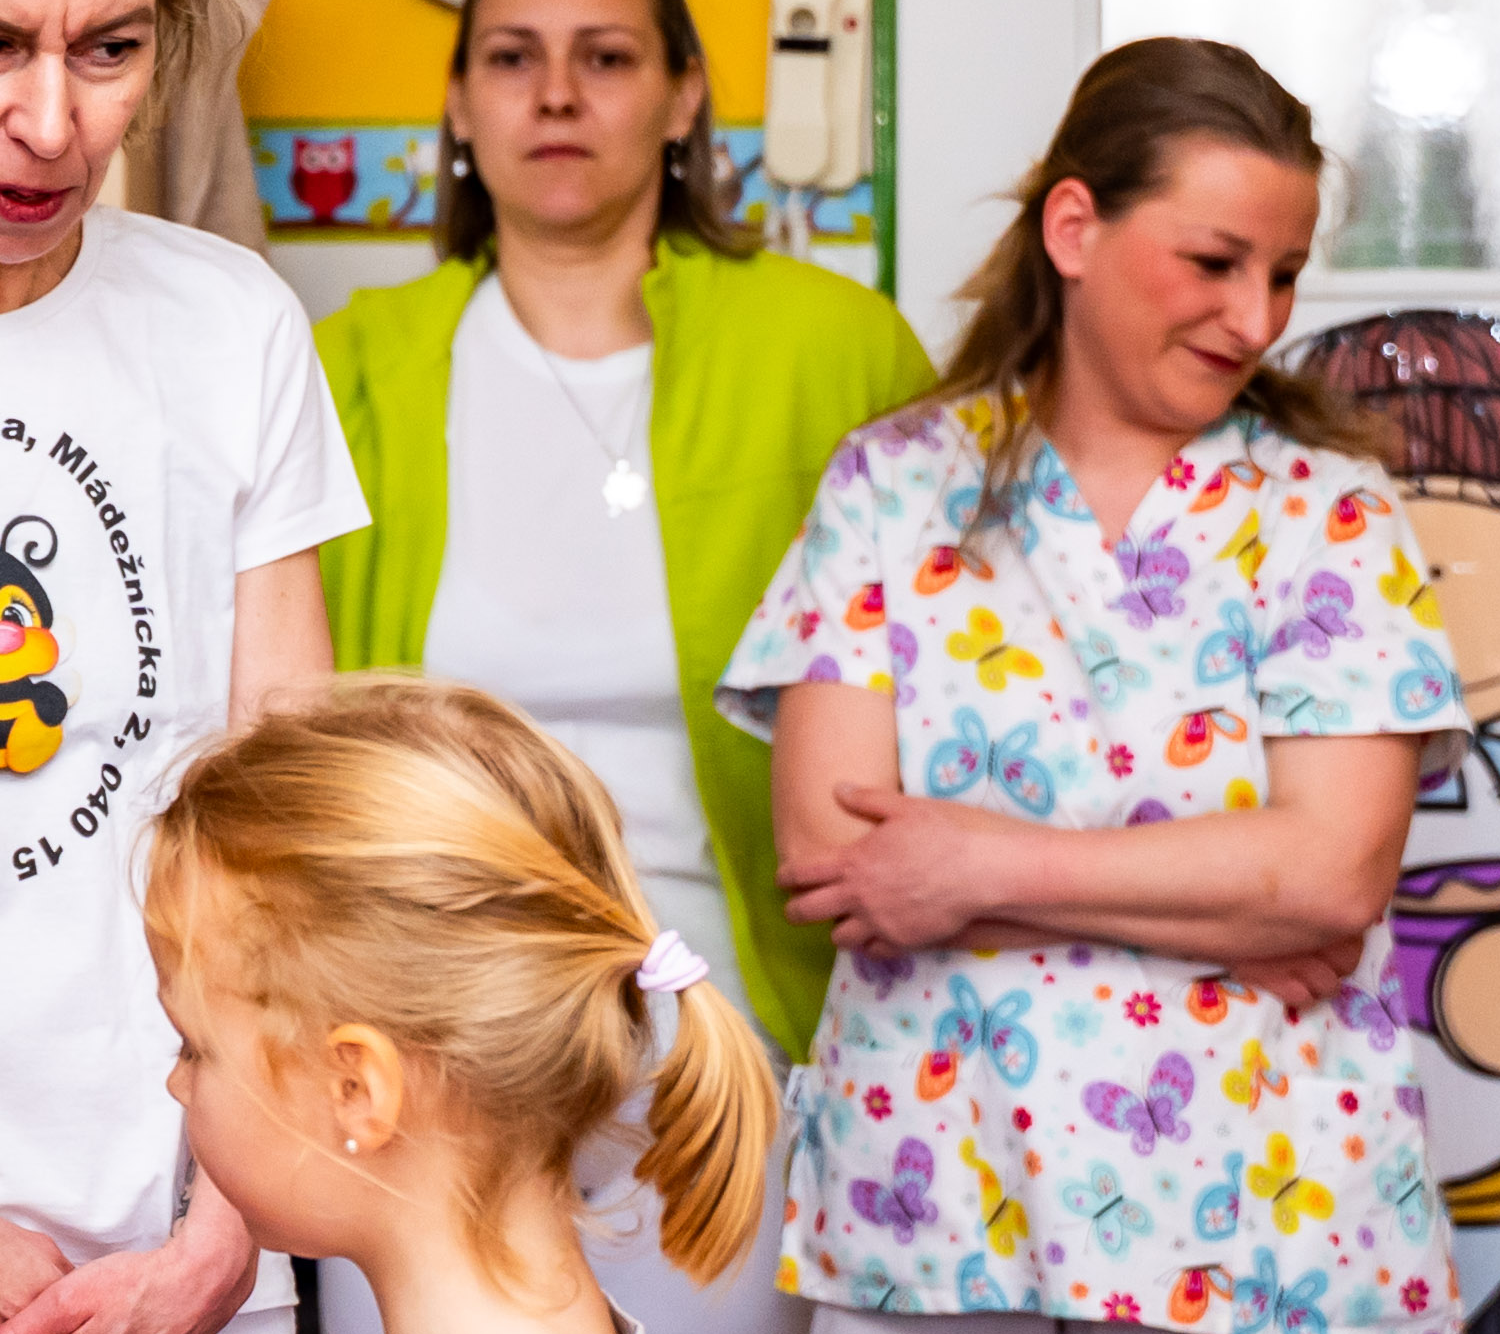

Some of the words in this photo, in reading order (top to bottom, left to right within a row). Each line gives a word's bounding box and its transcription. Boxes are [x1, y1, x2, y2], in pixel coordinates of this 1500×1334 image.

[49, 432, 162, 699] Mládežnícka
[113, 712, 152, 750] 2,
[70, 763, 123, 837] 040
[12, 837, 64, 881] 15
